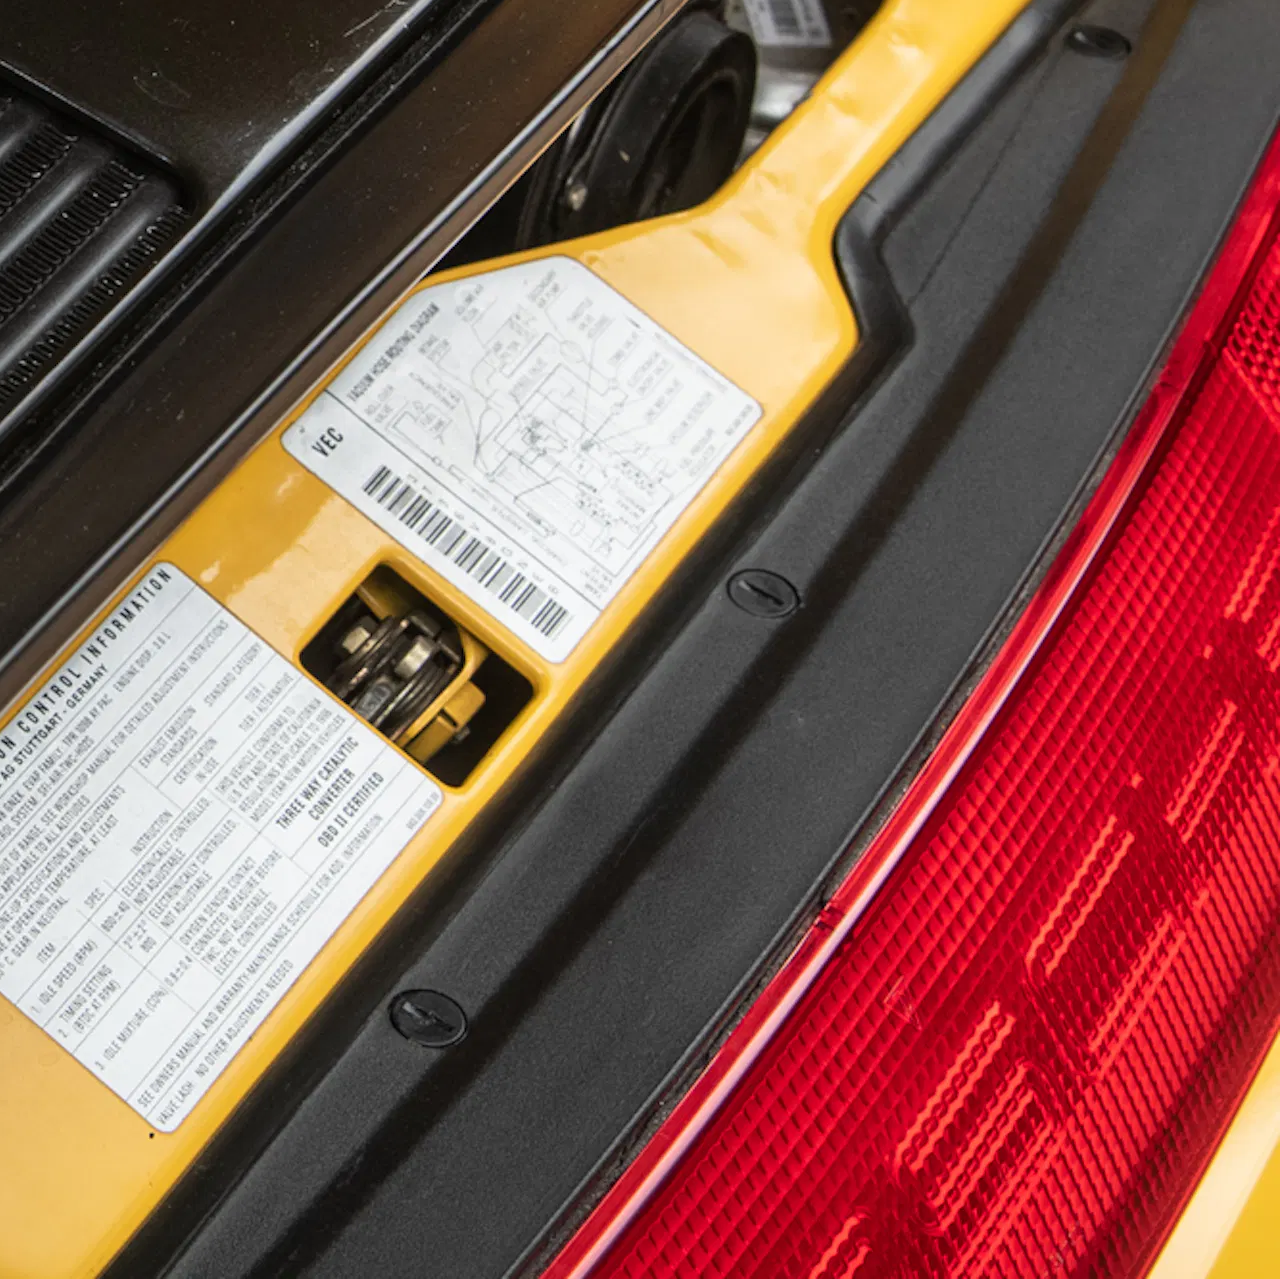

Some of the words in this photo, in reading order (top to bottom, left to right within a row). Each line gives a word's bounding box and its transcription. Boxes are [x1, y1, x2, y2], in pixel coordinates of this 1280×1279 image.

[367, 355, 391, 378] HOSE
[408, 301, 441, 334] DIAGRAM
[311, 425, 345, 459] VEC
[15, 664, 82, 733] CONTROL
[79, 567, 172, 665] INFORMATION
[112, 664, 140, 693] ENGINE
[12, 712, 64, 766] STUTTGART
[64, 662, 110, 709] GERMANY
[137, 735, 169, 769] EXHAUST
[163, 704, 198, 741] EMISSION
[228, 749, 258, 780] VEHICLE
[251, 712, 289, 753] CONFORMS
[282, 704, 297, 718] TO
[237, 773, 255, 791] EPA
[249, 758, 268, 778] AND
[262, 740, 284, 763] STATE
[278, 731, 292, 745] OF
[286, 696, 323, 736] CALIFORNIA
[7, 847, 22, 861] OF
[39, 808, 57, 826] SEE
[52, 771, 91, 813] WORKSHOP
[85, 744, 116, 776] MANUAL
[110, 730, 128, 748] FOR
[122, 700, 156, 735] DETAILED
[149, 661, 191, 705] ADJUSTMENT
[159, 725, 199, 767] STANDARDS
[171, 735, 218, 785] CERTIFICATION
[237, 766, 281, 814] REGULATIONS
[275, 730, 313, 771] APPLICABLE
[306, 721, 321, 735] TO
[248, 795, 275, 824] MODEL
[269, 779, 289, 800] YEAR
[283, 764, 303, 784] NEW
[296, 741, 322, 769] MOTOR
[275, 797, 306, 831] THREE
[299, 777, 324, 802] WAY
[316, 735, 360, 782] CATALYTIC
[306, 767, 356, 822] CONVERTER
[315, 823, 340, 848] OBD
[332, 813, 349, 828] II
[341, 770, 385, 818] CERTIFIED
[18, 845, 71, 903] SPECIFICATIONS
[64, 830, 84, 851] AND
[78, 783, 126, 836] ADJUSTMENTS
[34, 840, 49, 855] TO
[42, 827, 60, 845] ALL
[129, 808, 174, 857] INSTRUCTION
[2, 929, 16, 943] AT
[10, 892, 50, 934] OPERATING
[88, 833, 102, 847] AT
[96, 813, 120, 838] LEAST
[121, 837, 174, 897] ELECTRONICALLY
[133, 887, 151, 906] NOT
[147, 860, 201, 920] ELECTRONICALLY
[226, 875, 260, 913] MEASURE
[253, 849, 282, 880] BEFORE
[159, 911, 178, 929] NOT
[178, 912, 209, 946] OXYGEN
[202, 885, 232, 918] SENSOR
[226, 855, 257, 889] CONTACT
[9, 934, 32, 958] GEAR
[26, 924, 41, 939] IN
[35, 941, 57, 964] ITEM
[216, 928, 236, 948] NOT
[37, 984, 58, 1006] IDLE
[52, 960, 79, 989] SPEED
[71, 937, 99, 967] (RPM)
[59, 993, 87, 1024] TIMING
[81, 963, 113, 998] SETTING
[96, 977, 122, 1004] RPM)
[136, 1088, 155, 1108] SEE
[174, 1027, 206, 1062] MANUAL
[200, 1010, 220, 1031] AND
[286, 887, 321, 927] SCHEDULE
[315, 873, 333, 892] FOR
[70, 1006, 97, 1034] (BTDC
[90, 998, 104, 1012] AT
[102, 1039, 123, 1062] IDLE
[116, 1007, 150, 1045] MIXTURE
[155, 1098, 180, 1126] VALVE
[193, 1061, 210, 1079] NO
[204, 1037, 230, 1066] OTHER
[223, 988, 270, 1042] ADJUSTMENTS
